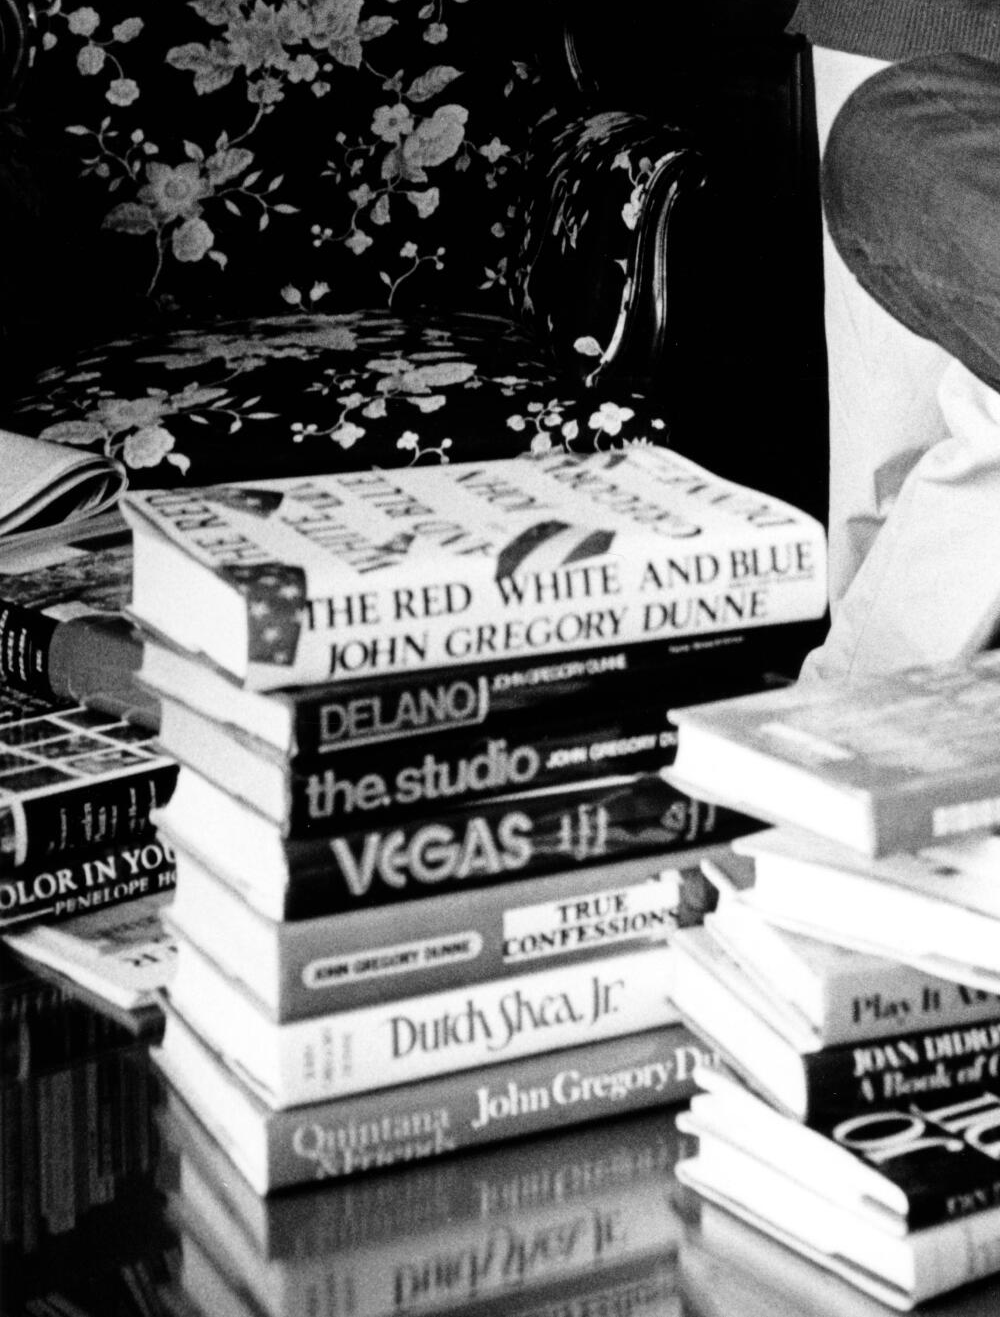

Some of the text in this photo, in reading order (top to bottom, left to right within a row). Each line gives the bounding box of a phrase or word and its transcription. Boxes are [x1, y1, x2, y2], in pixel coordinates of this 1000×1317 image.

[303, 541, 813, 631] THE RED WHITE AND BLUE
[326, 630, 428, 680] JOHN
[445, 607, 627, 658] GREGORY
[643, 591, 769, 633] DUNNE
[319, 680, 477, 739] DELANO
[546, 731, 679, 769] JOHN GREGORY DU
[82, 855, 117, 887] IN
[122, 844, 177, 874] YOU
[330, 810, 535, 897] VEGAS
[55, 877, 149, 916] PENELOPE
[557, 893, 629, 925] TRUE
[503, 907, 681, 958] CONFESSIONS
[387, 999, 493, 1059] Dutch
[590, 976, 625, 1025] Jr.
[853, 1039, 919, 1077] JOAN
[883, 1062, 951, 1098] Book
[956, 1054, 986, 1084] of
[471, 1082, 550, 1130] John
[553, 1060, 673, 1105] Gregory
